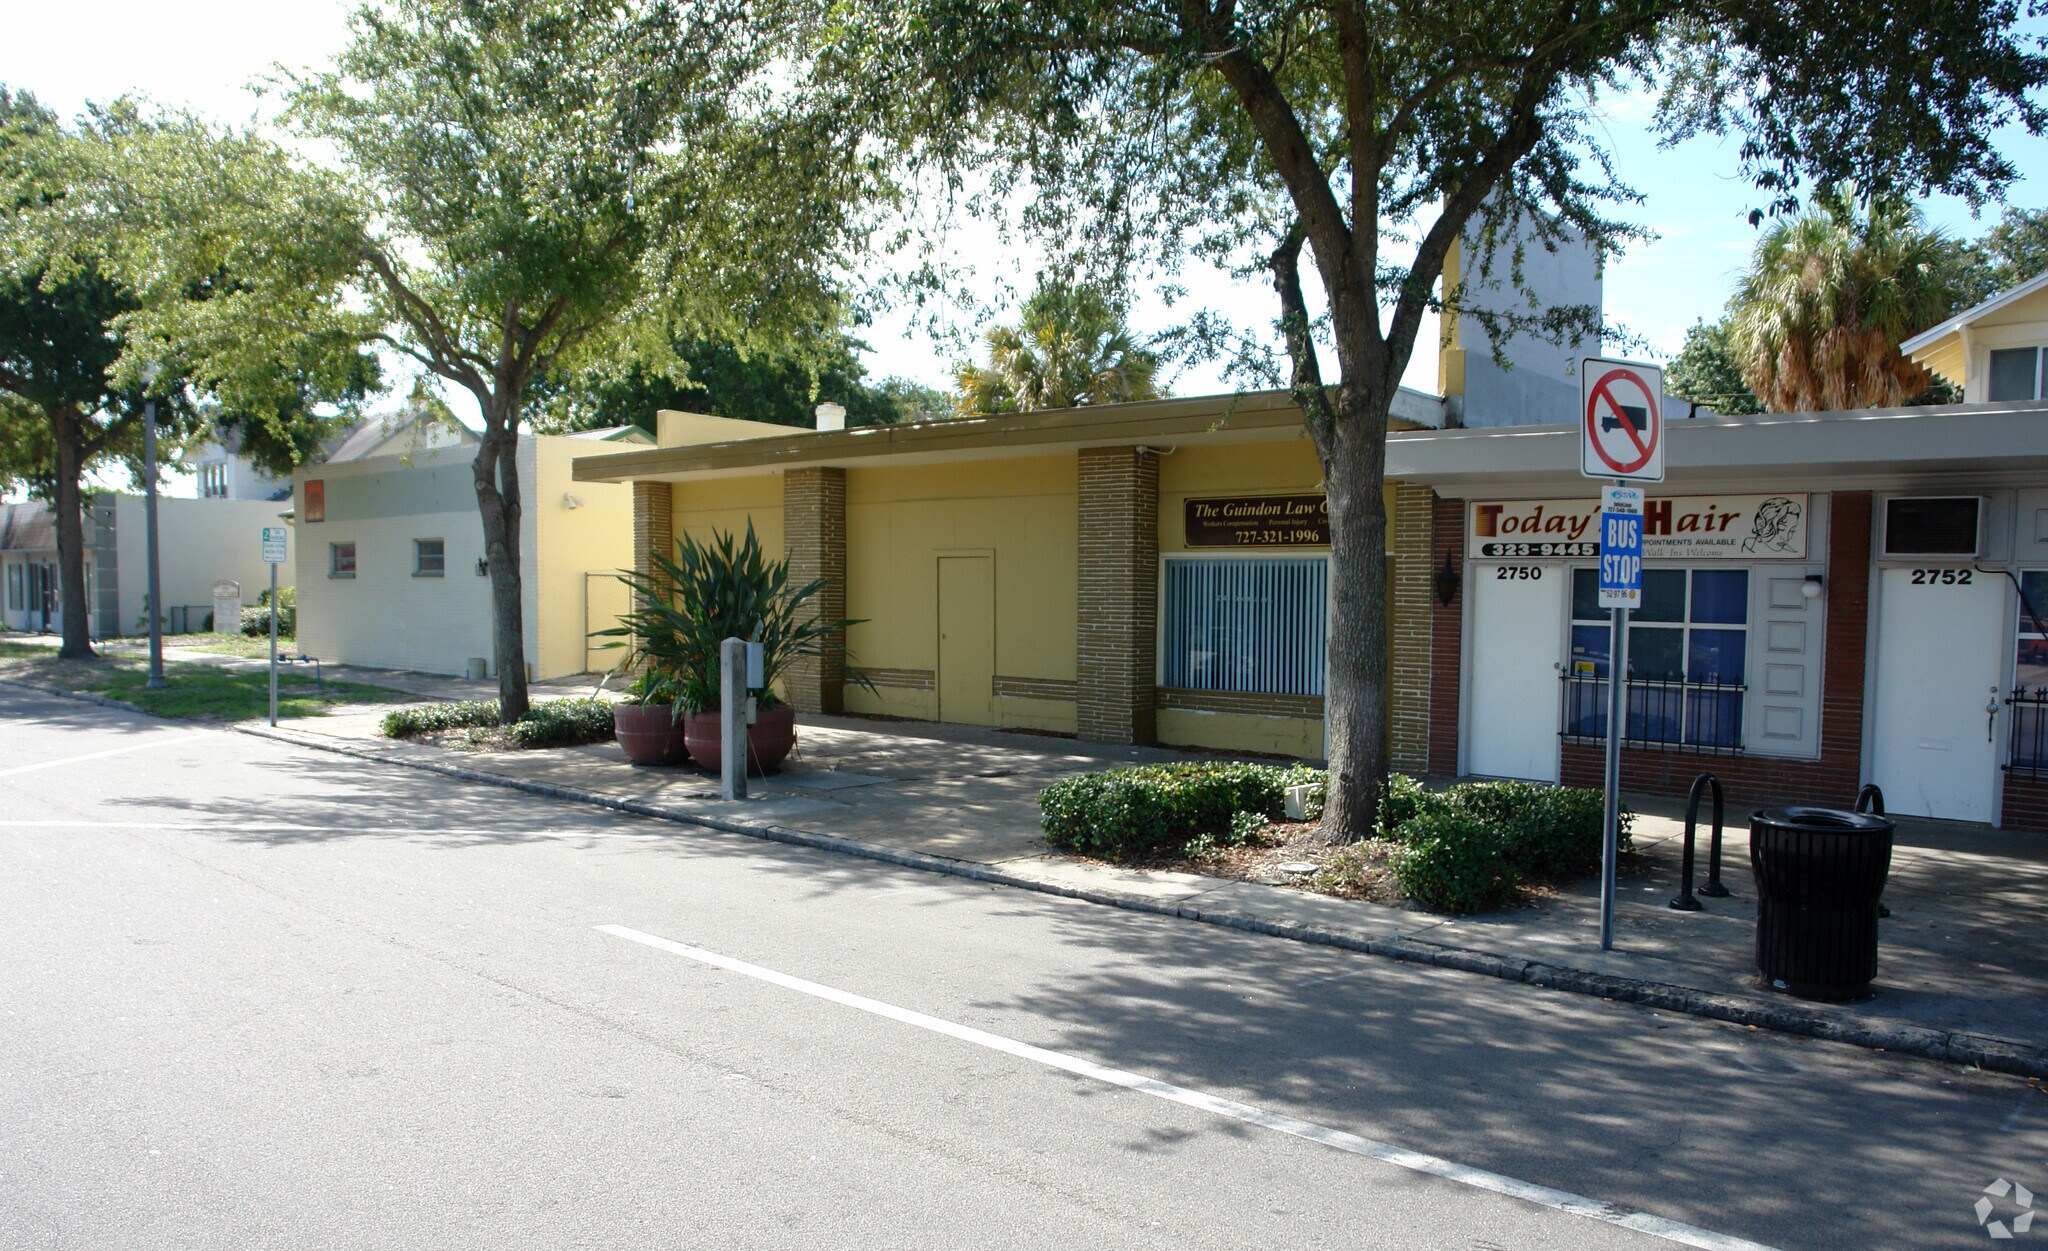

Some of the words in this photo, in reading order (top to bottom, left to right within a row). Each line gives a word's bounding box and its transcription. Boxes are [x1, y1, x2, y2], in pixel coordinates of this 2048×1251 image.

[1195, 503, 1219, 517] The
[1223, 502, 1281, 517] Guindon
[1285, 501, 1315, 515] Law
[1269, 518, 1290, 526] Personal
[1291, 518, 1307, 526] Injury
[1475, 505, 1602, 540] Today'
[1643, 500, 1740, 535] Hair
[1235, 530, 1319, 543] 727-321-1996
[1608, 518, 1637, 549] BUS
[1695, 538, 1736, 546] AVAILABLE
[1492, 543, 1594, 556] 323-9445
[1686, 547, 1723, 557] Welcome
[1497, 566, 1542, 580] 2750
[1603, 554, 1640, 584] STOP
[1911, 569, 1972, 585] 2752
